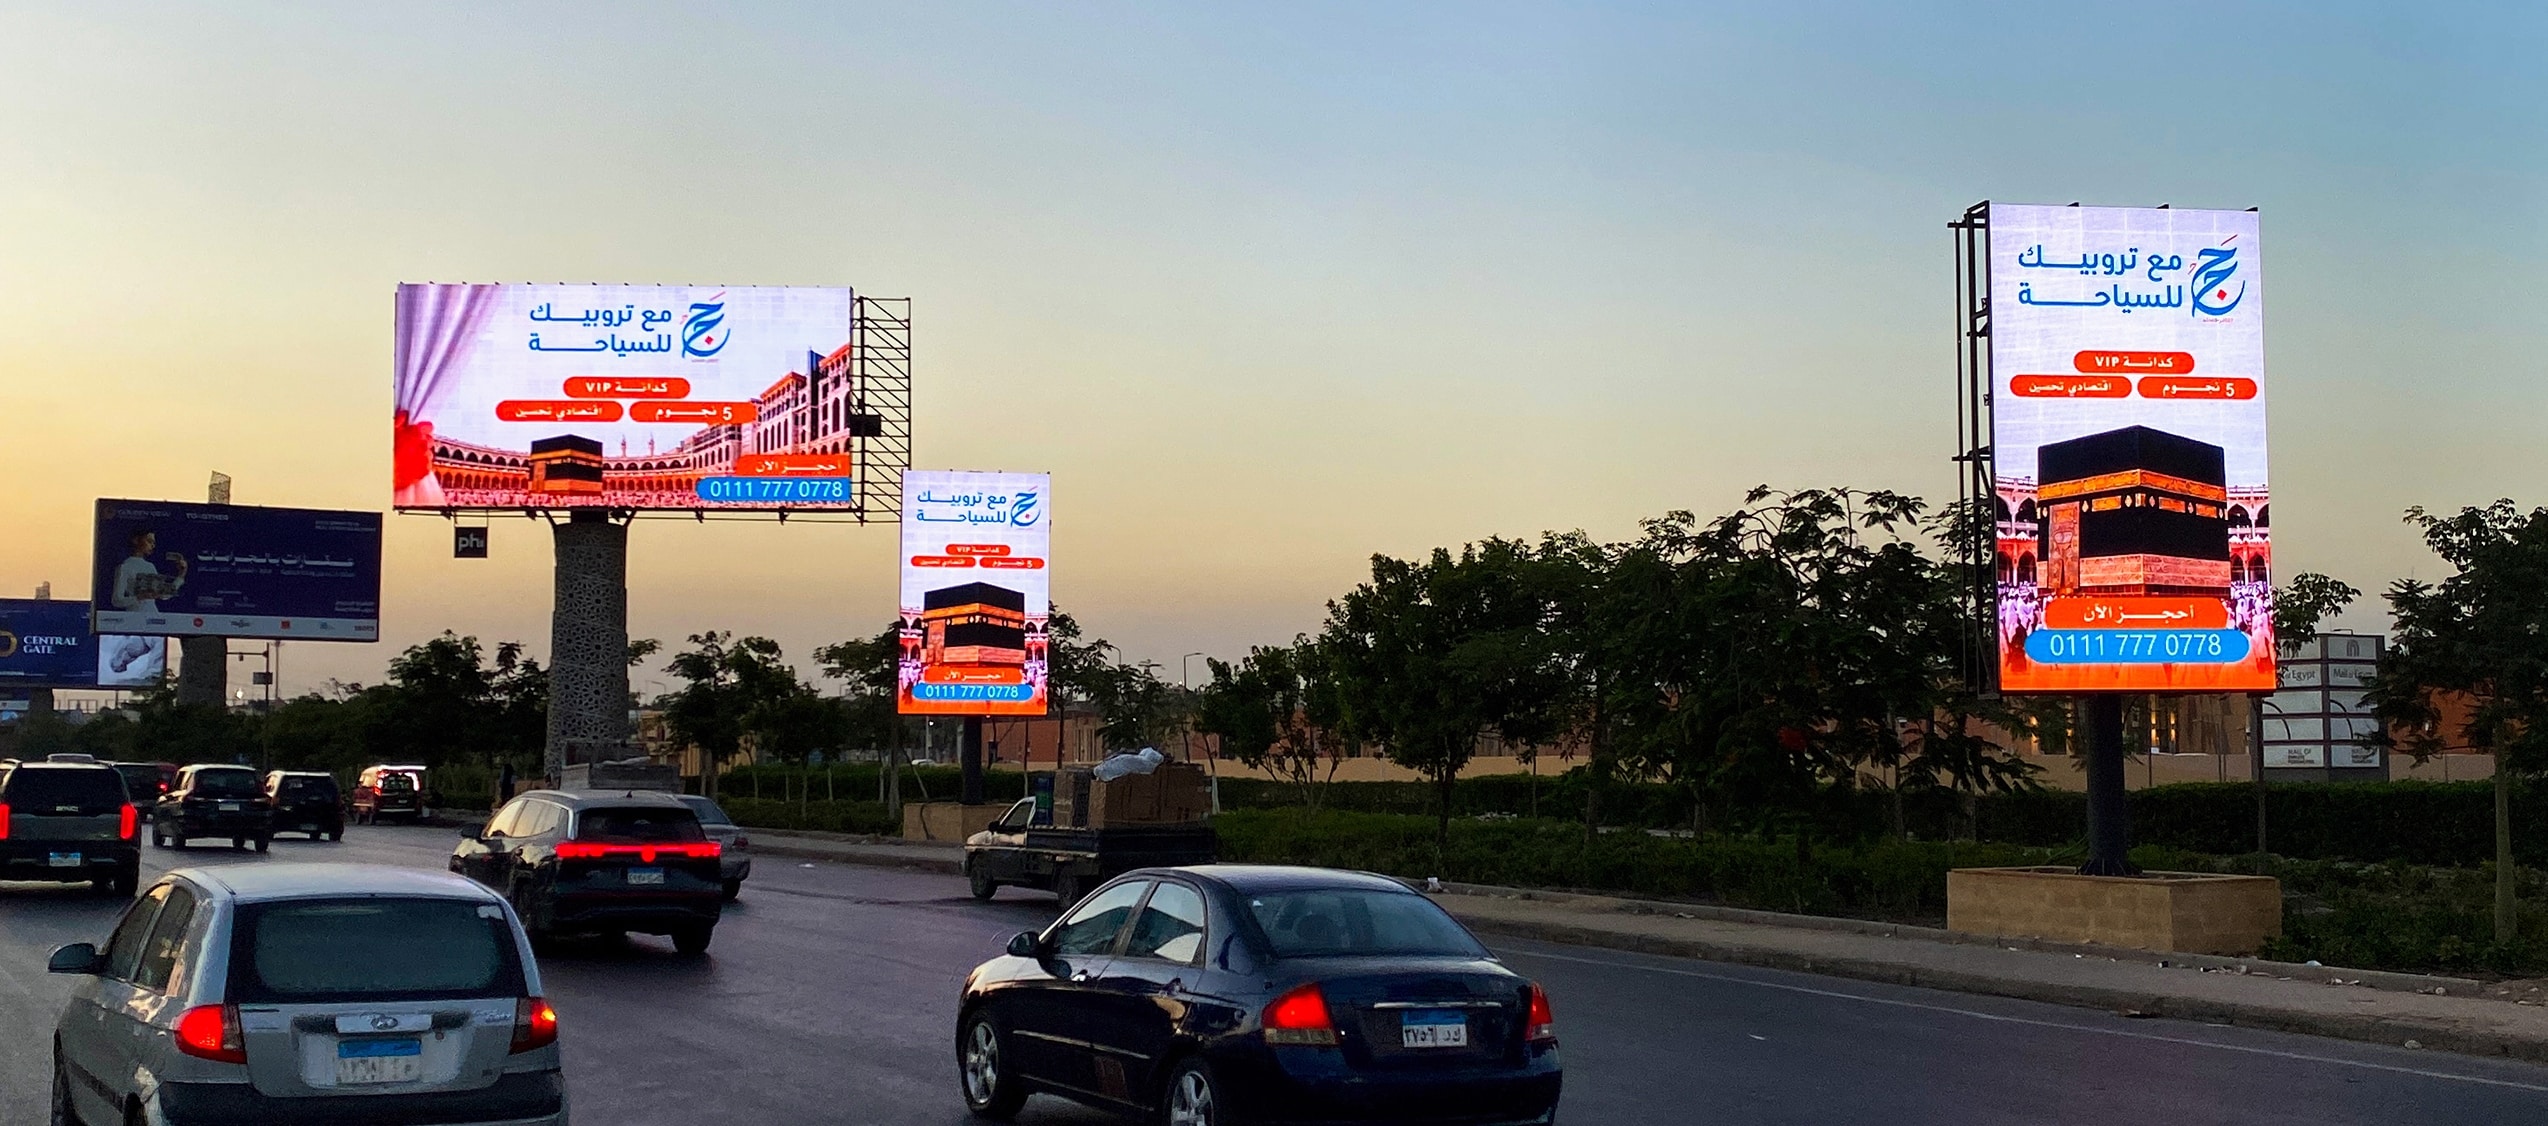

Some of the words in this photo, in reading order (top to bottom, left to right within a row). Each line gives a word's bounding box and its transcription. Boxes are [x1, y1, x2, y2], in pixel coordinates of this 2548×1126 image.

[2018, 244, 2138, 275] تروبيك
[2147, 254, 2182, 282] مع
[2018, 282, 2182, 314] للسياحة
[530, 302, 634, 327] تروبيك
[641, 310, 672, 332] مع
[529, 333, 671, 357] للسياحة
[2094, 356, 2119, 367] VIP
[585, 382, 612, 393] VIP
[2068, 381, 2112, 396] اقتصادي
[2163, 381, 2221, 396] نجوم
[2225, 382, 2235, 397] 5
[655, 407, 717, 420] نجوم
[722, 407, 733, 420] 5
[710, 481, 752, 497] 0111
[761, 481, 793, 497] 777
[799, 481, 843, 497] 0778
[988, 496, 1007, 510] مع
[916, 509, 1006, 526] للسياحة
[1027, 560, 1033, 569] 5
[23, 635, 78, 646] CENTRAL
[2050, 634, 2104, 656] 0111
[2115, 634, 2157, 656] 777
[2165, 633, 2222, 656] 0778
[2292, 669, 2316, 681] Egypt
[925, 685, 955, 697] 0111
[960, 685, 984, 697] 777
[987, 685, 1018, 698] 0778
